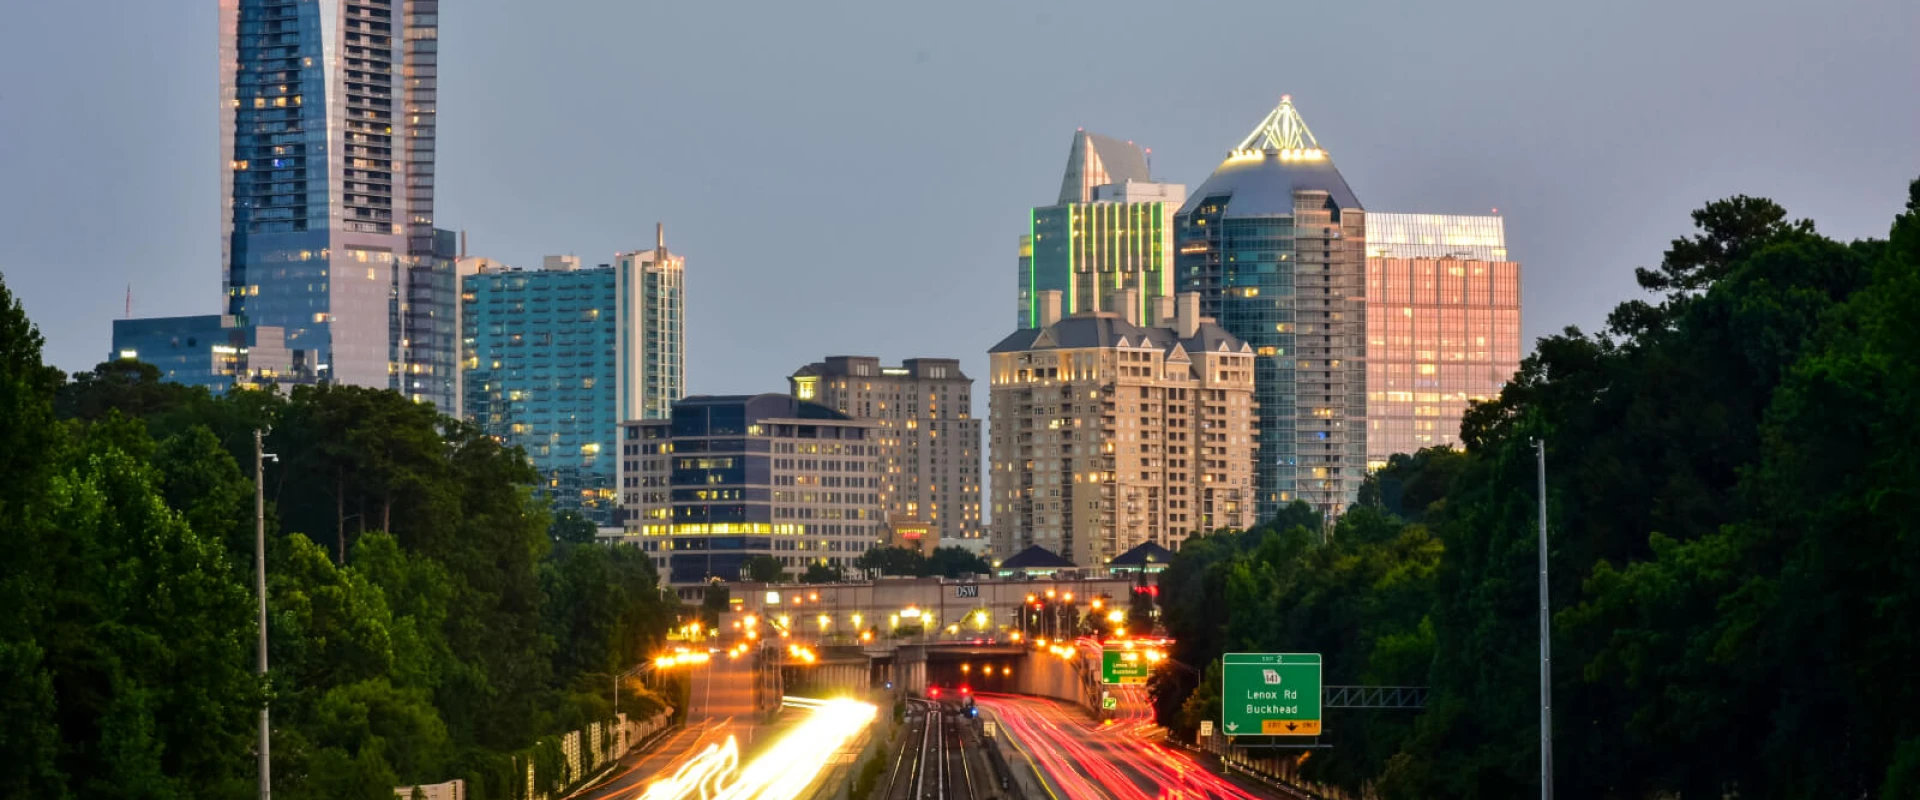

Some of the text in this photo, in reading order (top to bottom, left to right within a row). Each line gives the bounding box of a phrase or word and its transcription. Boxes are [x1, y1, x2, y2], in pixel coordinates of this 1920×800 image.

[956, 586, 978, 597] DSW
[1276, 655, 1283, 664] 2
[1266, 674, 1278, 682] 141
[1247, 689, 1297, 700] Lenox Rd
[1246, 704, 1298, 714] Buckhead
